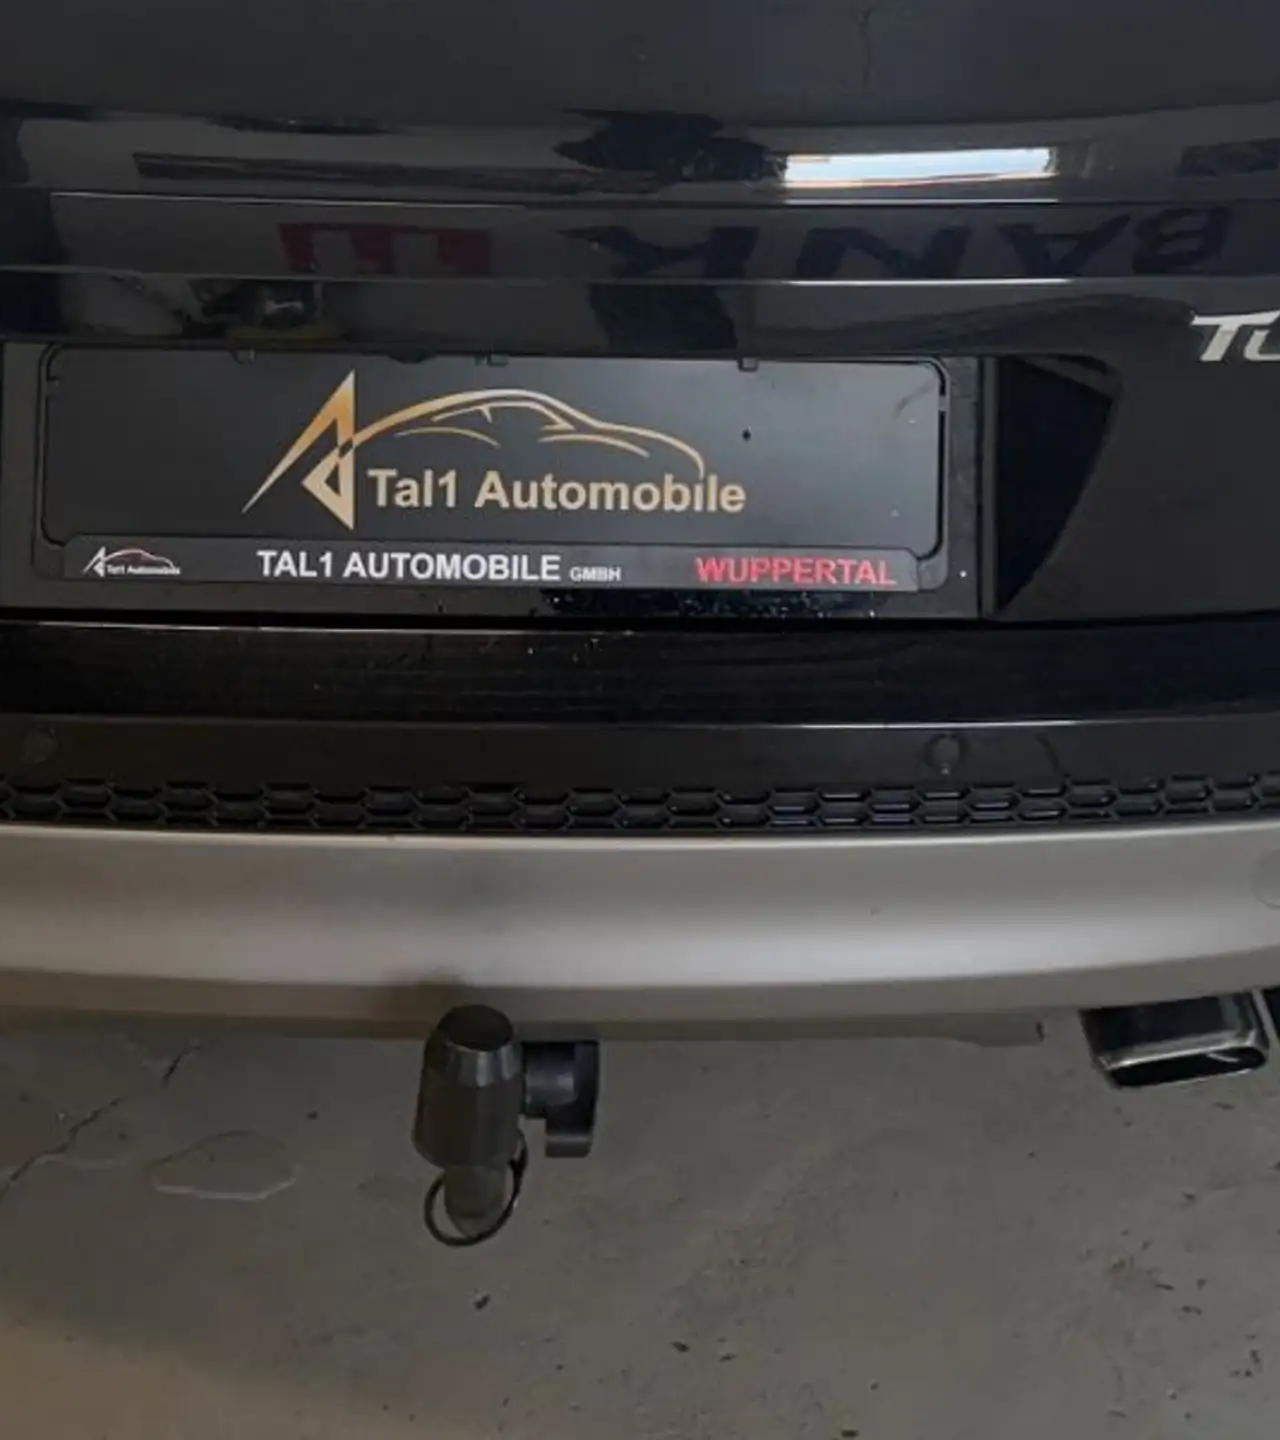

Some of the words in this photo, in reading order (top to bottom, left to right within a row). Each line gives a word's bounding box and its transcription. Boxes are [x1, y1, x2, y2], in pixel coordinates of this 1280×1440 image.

[367, 468, 458, 510] Tal1
[475, 470, 746, 513] Automobile
[256, 549, 333, 579] TAL1
[344, 551, 561, 582] AUTOMOBILE
[569, 565, 621, 582] GMBH
[696, 556, 898, 586] WUPPERTAL
